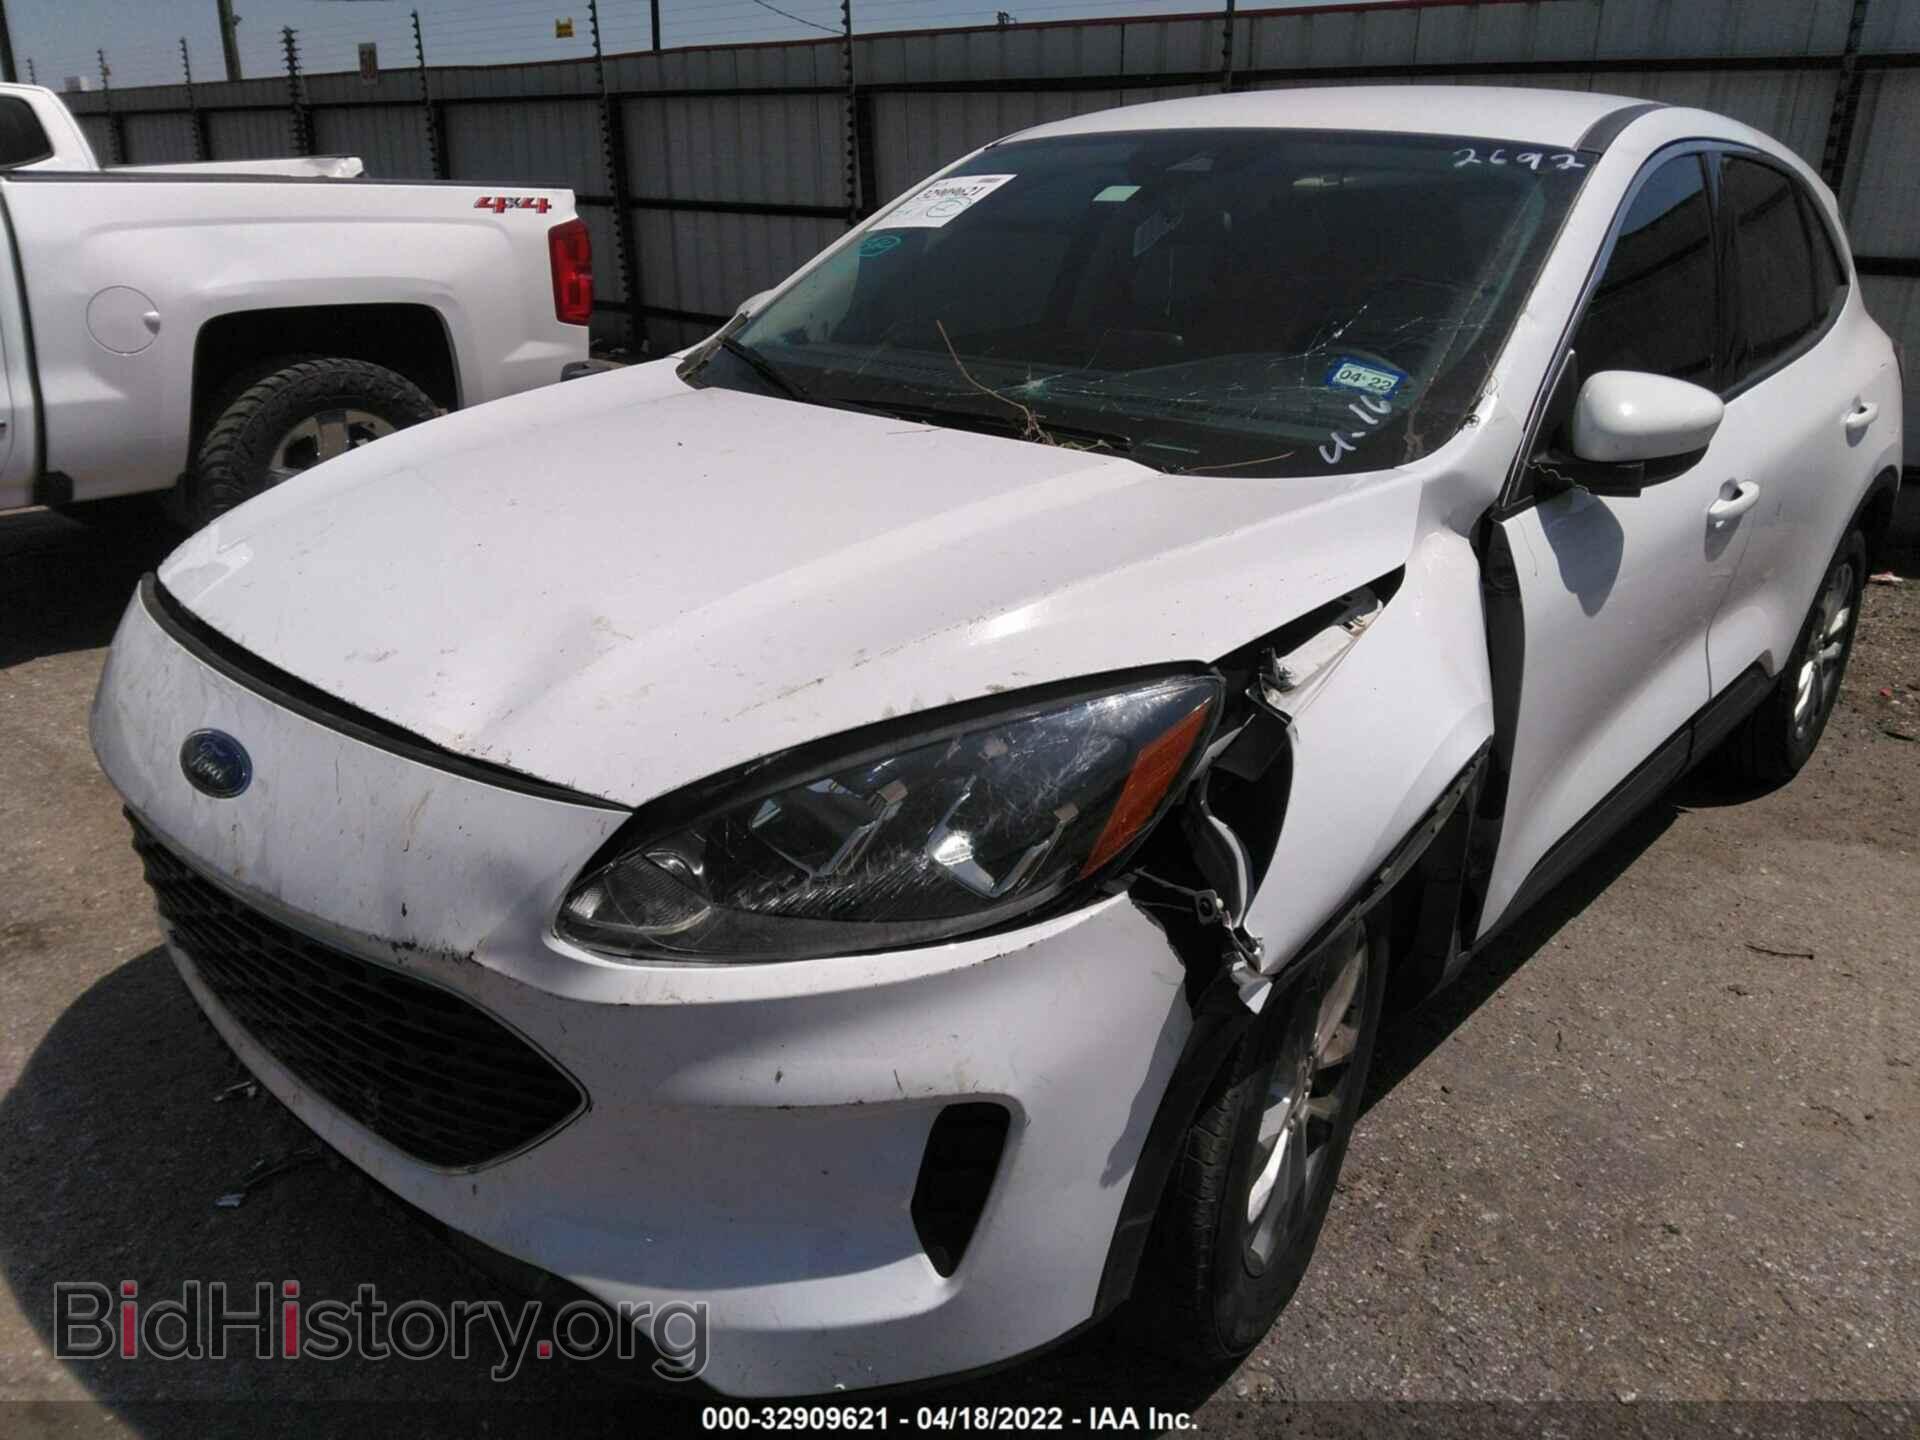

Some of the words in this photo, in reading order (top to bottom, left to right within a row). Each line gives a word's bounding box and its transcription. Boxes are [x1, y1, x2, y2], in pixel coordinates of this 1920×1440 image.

[1453, 148, 1586, 170] 2692
[1339, 369, 1362, 383] 04
[1367, 376, 1392, 391] 22
